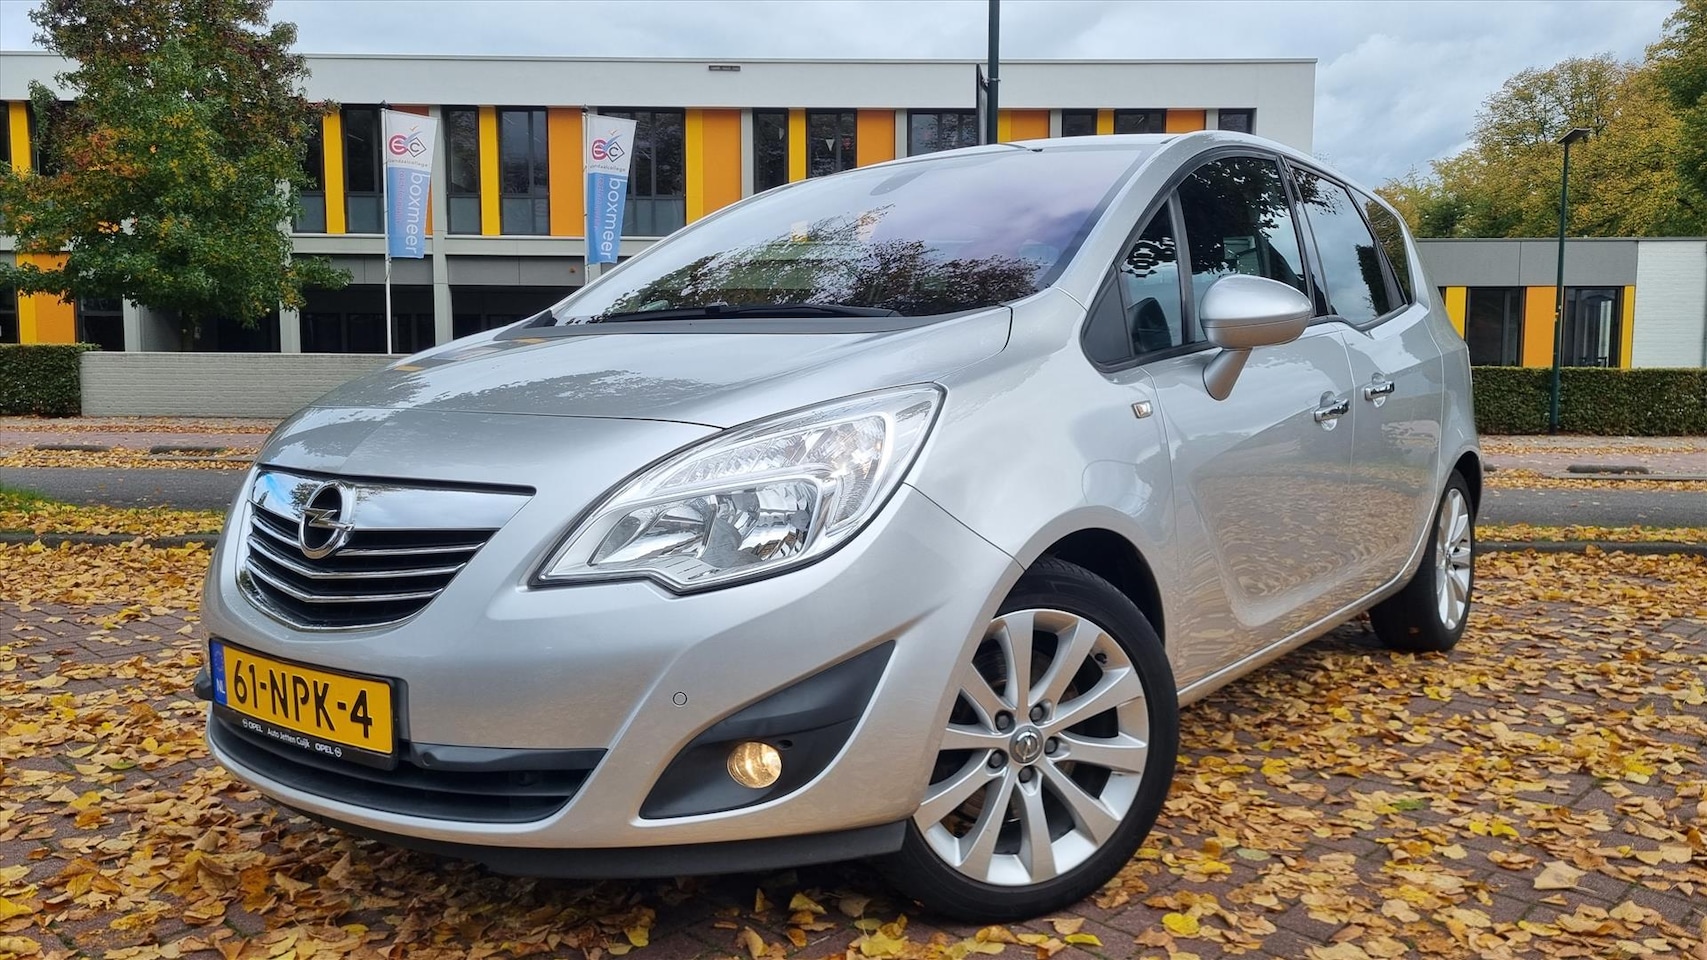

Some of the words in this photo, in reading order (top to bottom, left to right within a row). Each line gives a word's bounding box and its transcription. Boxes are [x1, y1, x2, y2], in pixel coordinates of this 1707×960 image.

[404, 172, 431, 254] boxmeer
[600, 177, 628, 259] boxmeer
[216, 677, 226, 694] NL
[233, 659, 373, 739] 61-NPK-4
[248, 721, 264, 733] OPEL
[267, 727, 280, 739] Auto
[296, 736, 310, 749] Cuijk
[315, 743, 334, 754] OPEL
